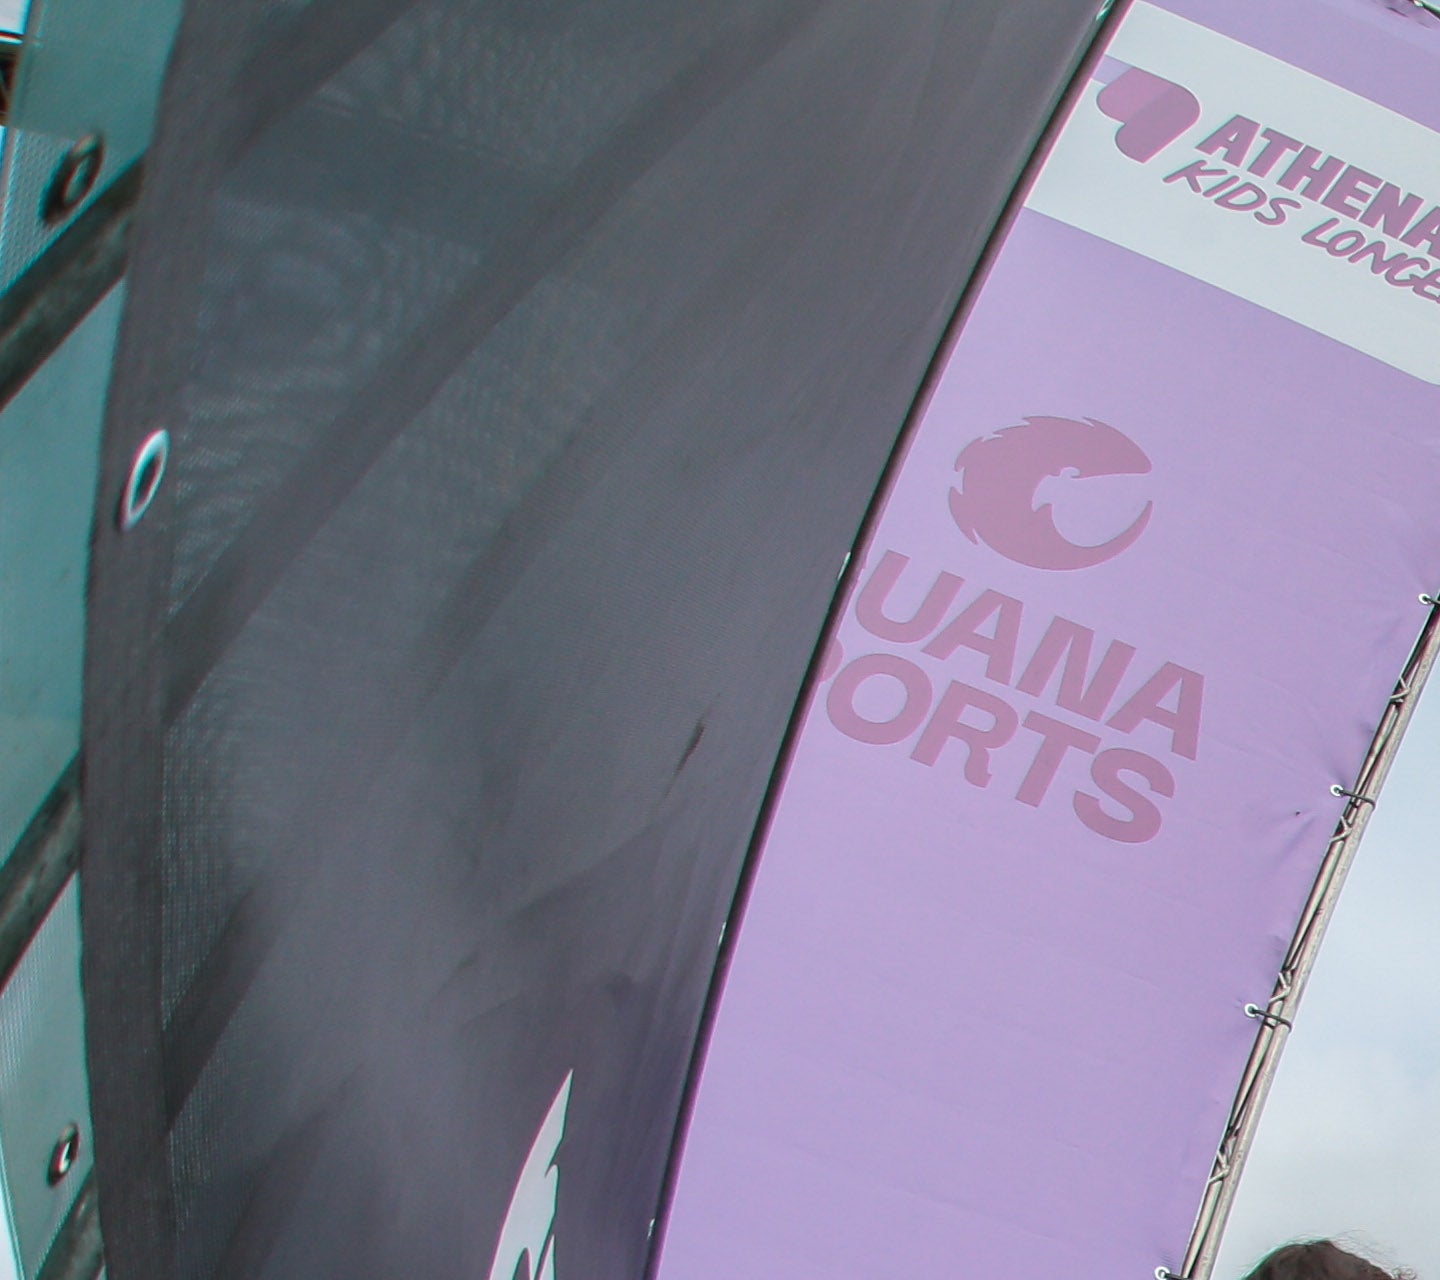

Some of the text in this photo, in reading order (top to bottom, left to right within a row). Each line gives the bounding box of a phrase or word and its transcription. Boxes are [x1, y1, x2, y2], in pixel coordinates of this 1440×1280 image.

[1164, 160, 1302, 223] KIDS
[826, 652, 1176, 843] ORTS
[855, 550, 1204, 760] UANA
